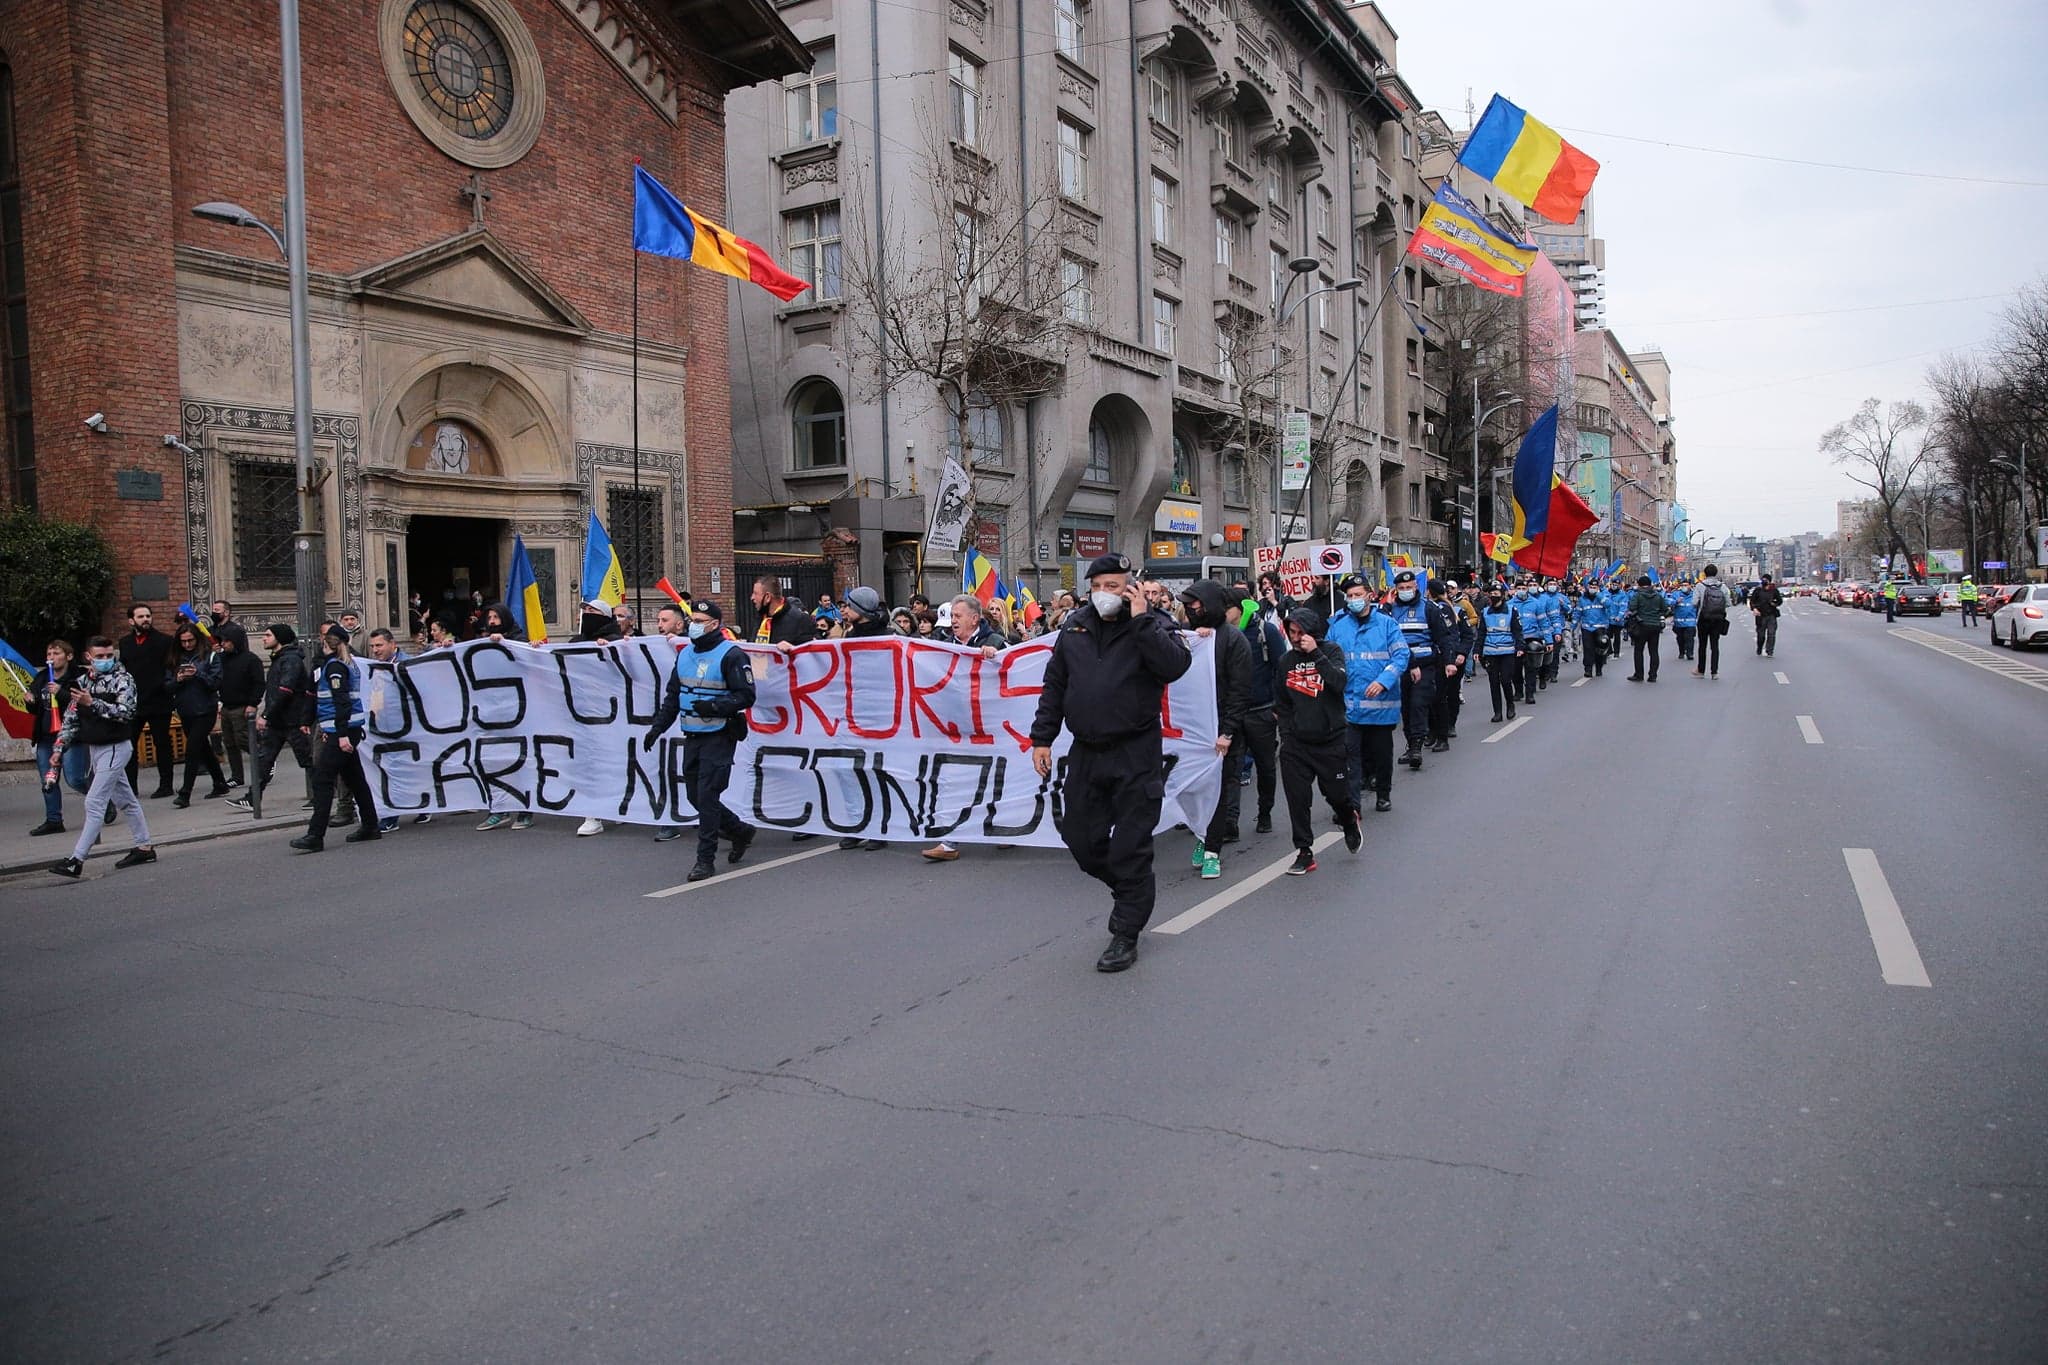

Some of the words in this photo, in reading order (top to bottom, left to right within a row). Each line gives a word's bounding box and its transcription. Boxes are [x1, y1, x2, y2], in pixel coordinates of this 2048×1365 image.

[1169, 519, 1197, 532] Aerotravel
[1258, 547, 1281, 562] ERA
[368, 642, 527, 739] JOS
[550, 643, 662, 725] CU
[372, 735, 576, 812] CARE
